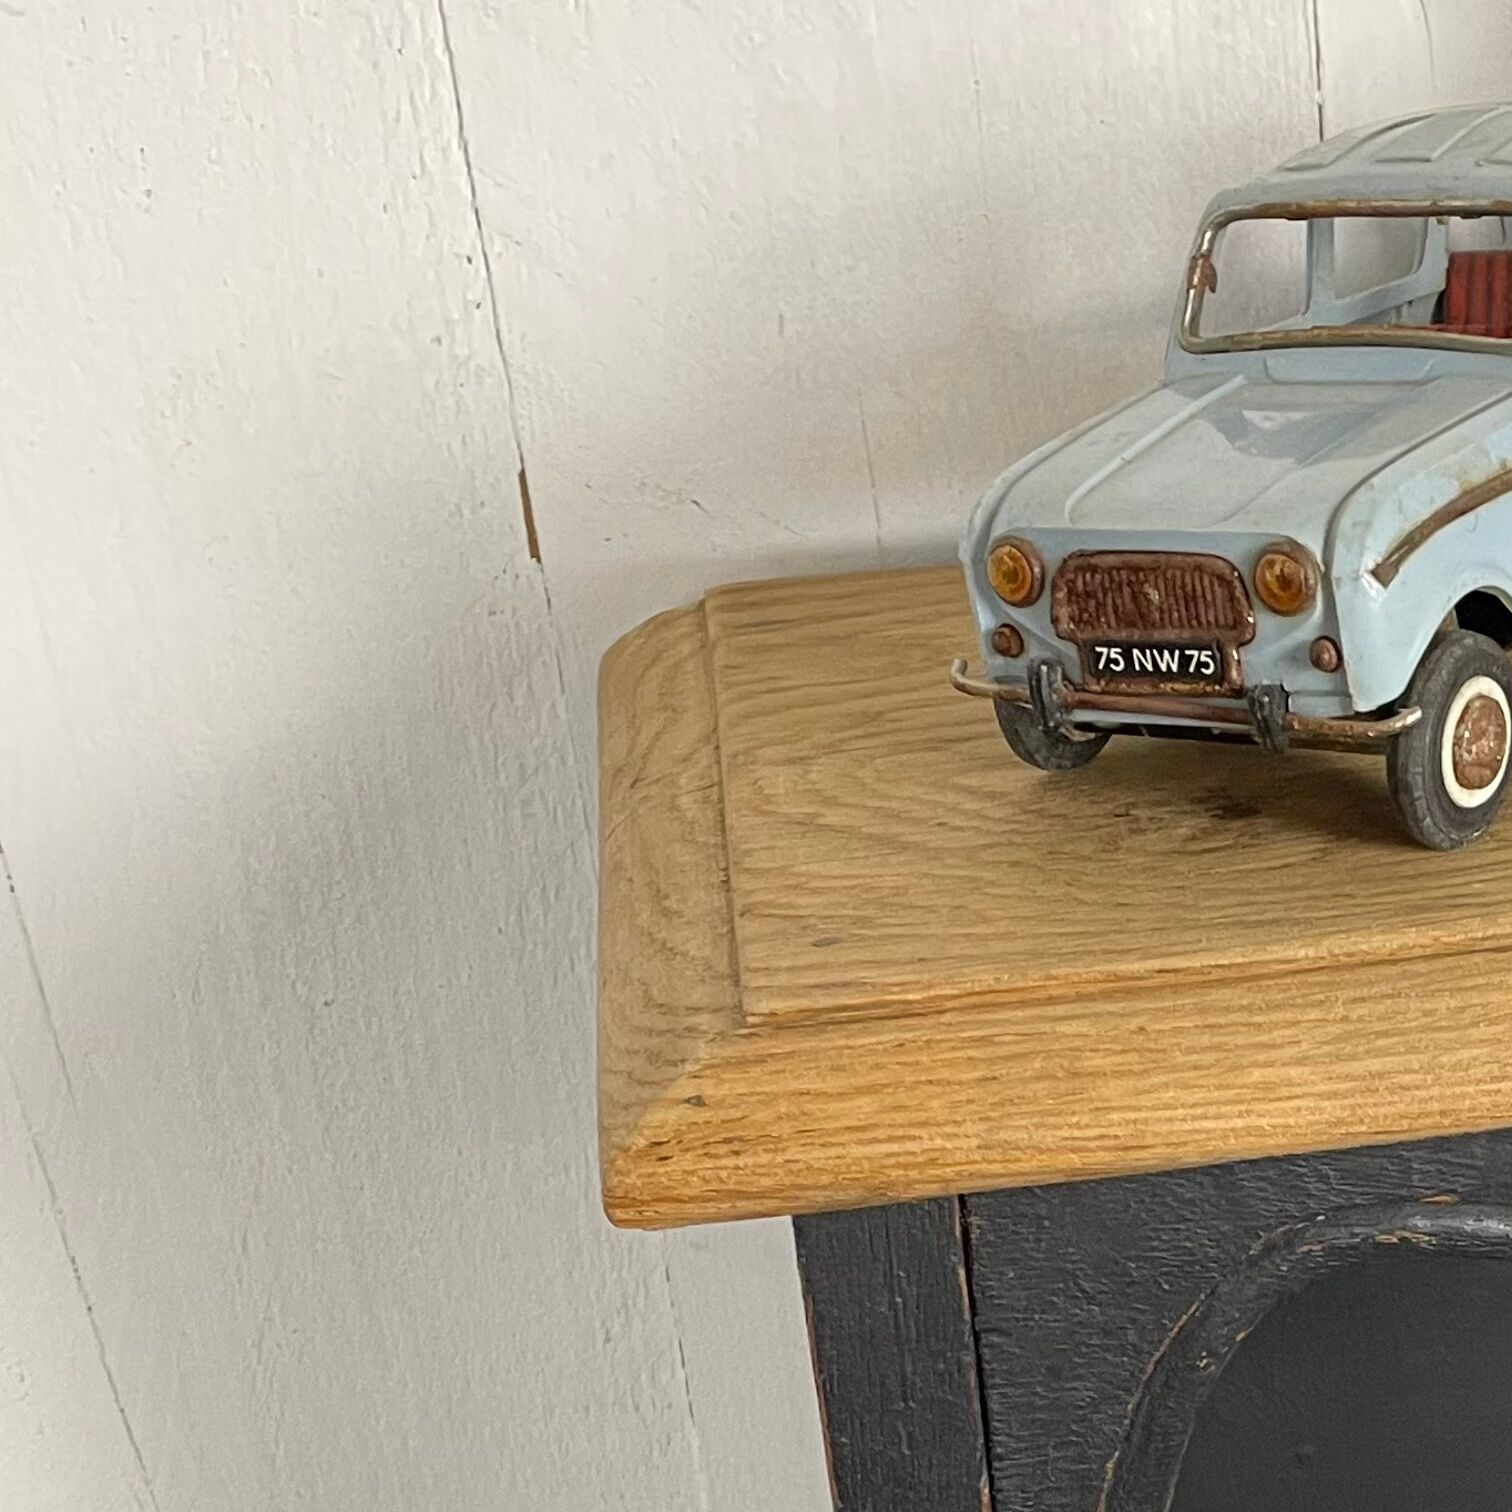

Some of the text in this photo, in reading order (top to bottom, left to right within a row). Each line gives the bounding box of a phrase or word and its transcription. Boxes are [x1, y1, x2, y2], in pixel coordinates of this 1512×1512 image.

[1094, 646, 1216, 676] 75 NW 75
